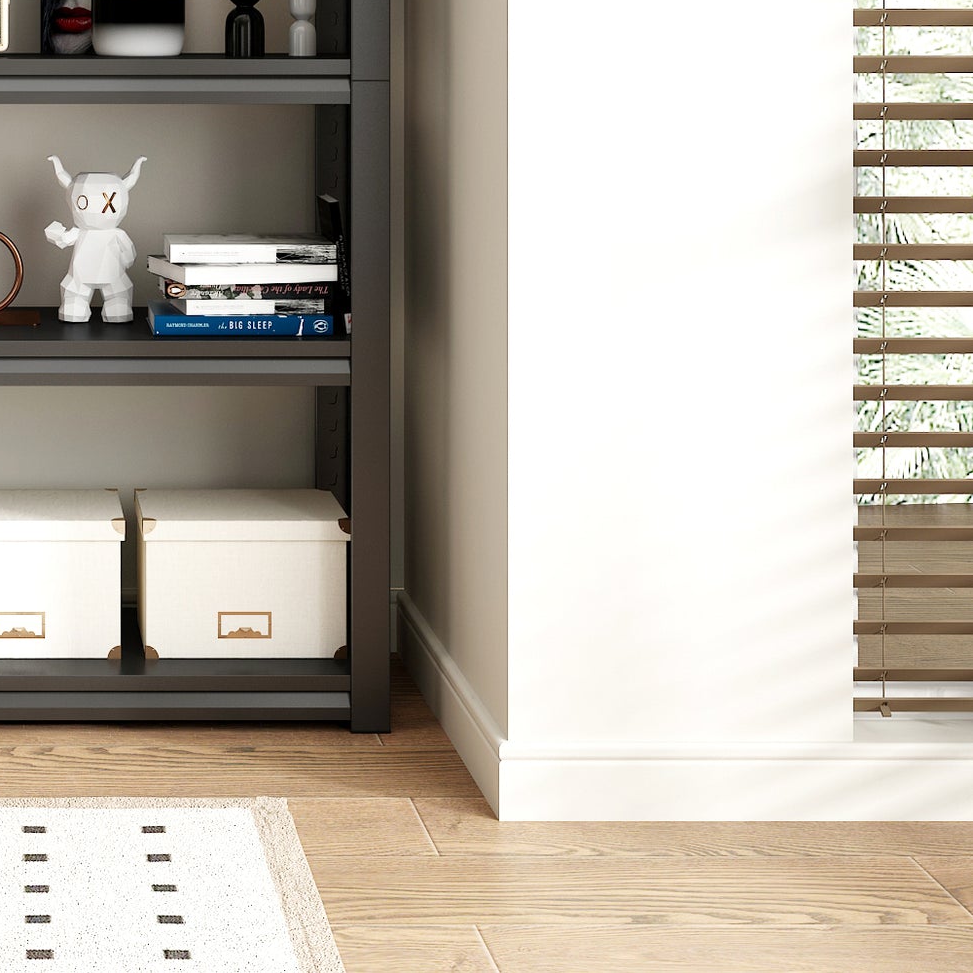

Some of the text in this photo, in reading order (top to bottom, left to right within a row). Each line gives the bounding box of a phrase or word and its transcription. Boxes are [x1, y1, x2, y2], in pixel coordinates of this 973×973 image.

[270, 286, 282, 294] the
[282, 284, 292, 295] of
[293, 284, 313, 294] Lady
[315, 286, 329, 294] The
[229, 321, 243, 330] BIG
[247, 321, 273, 330] SLEEP
